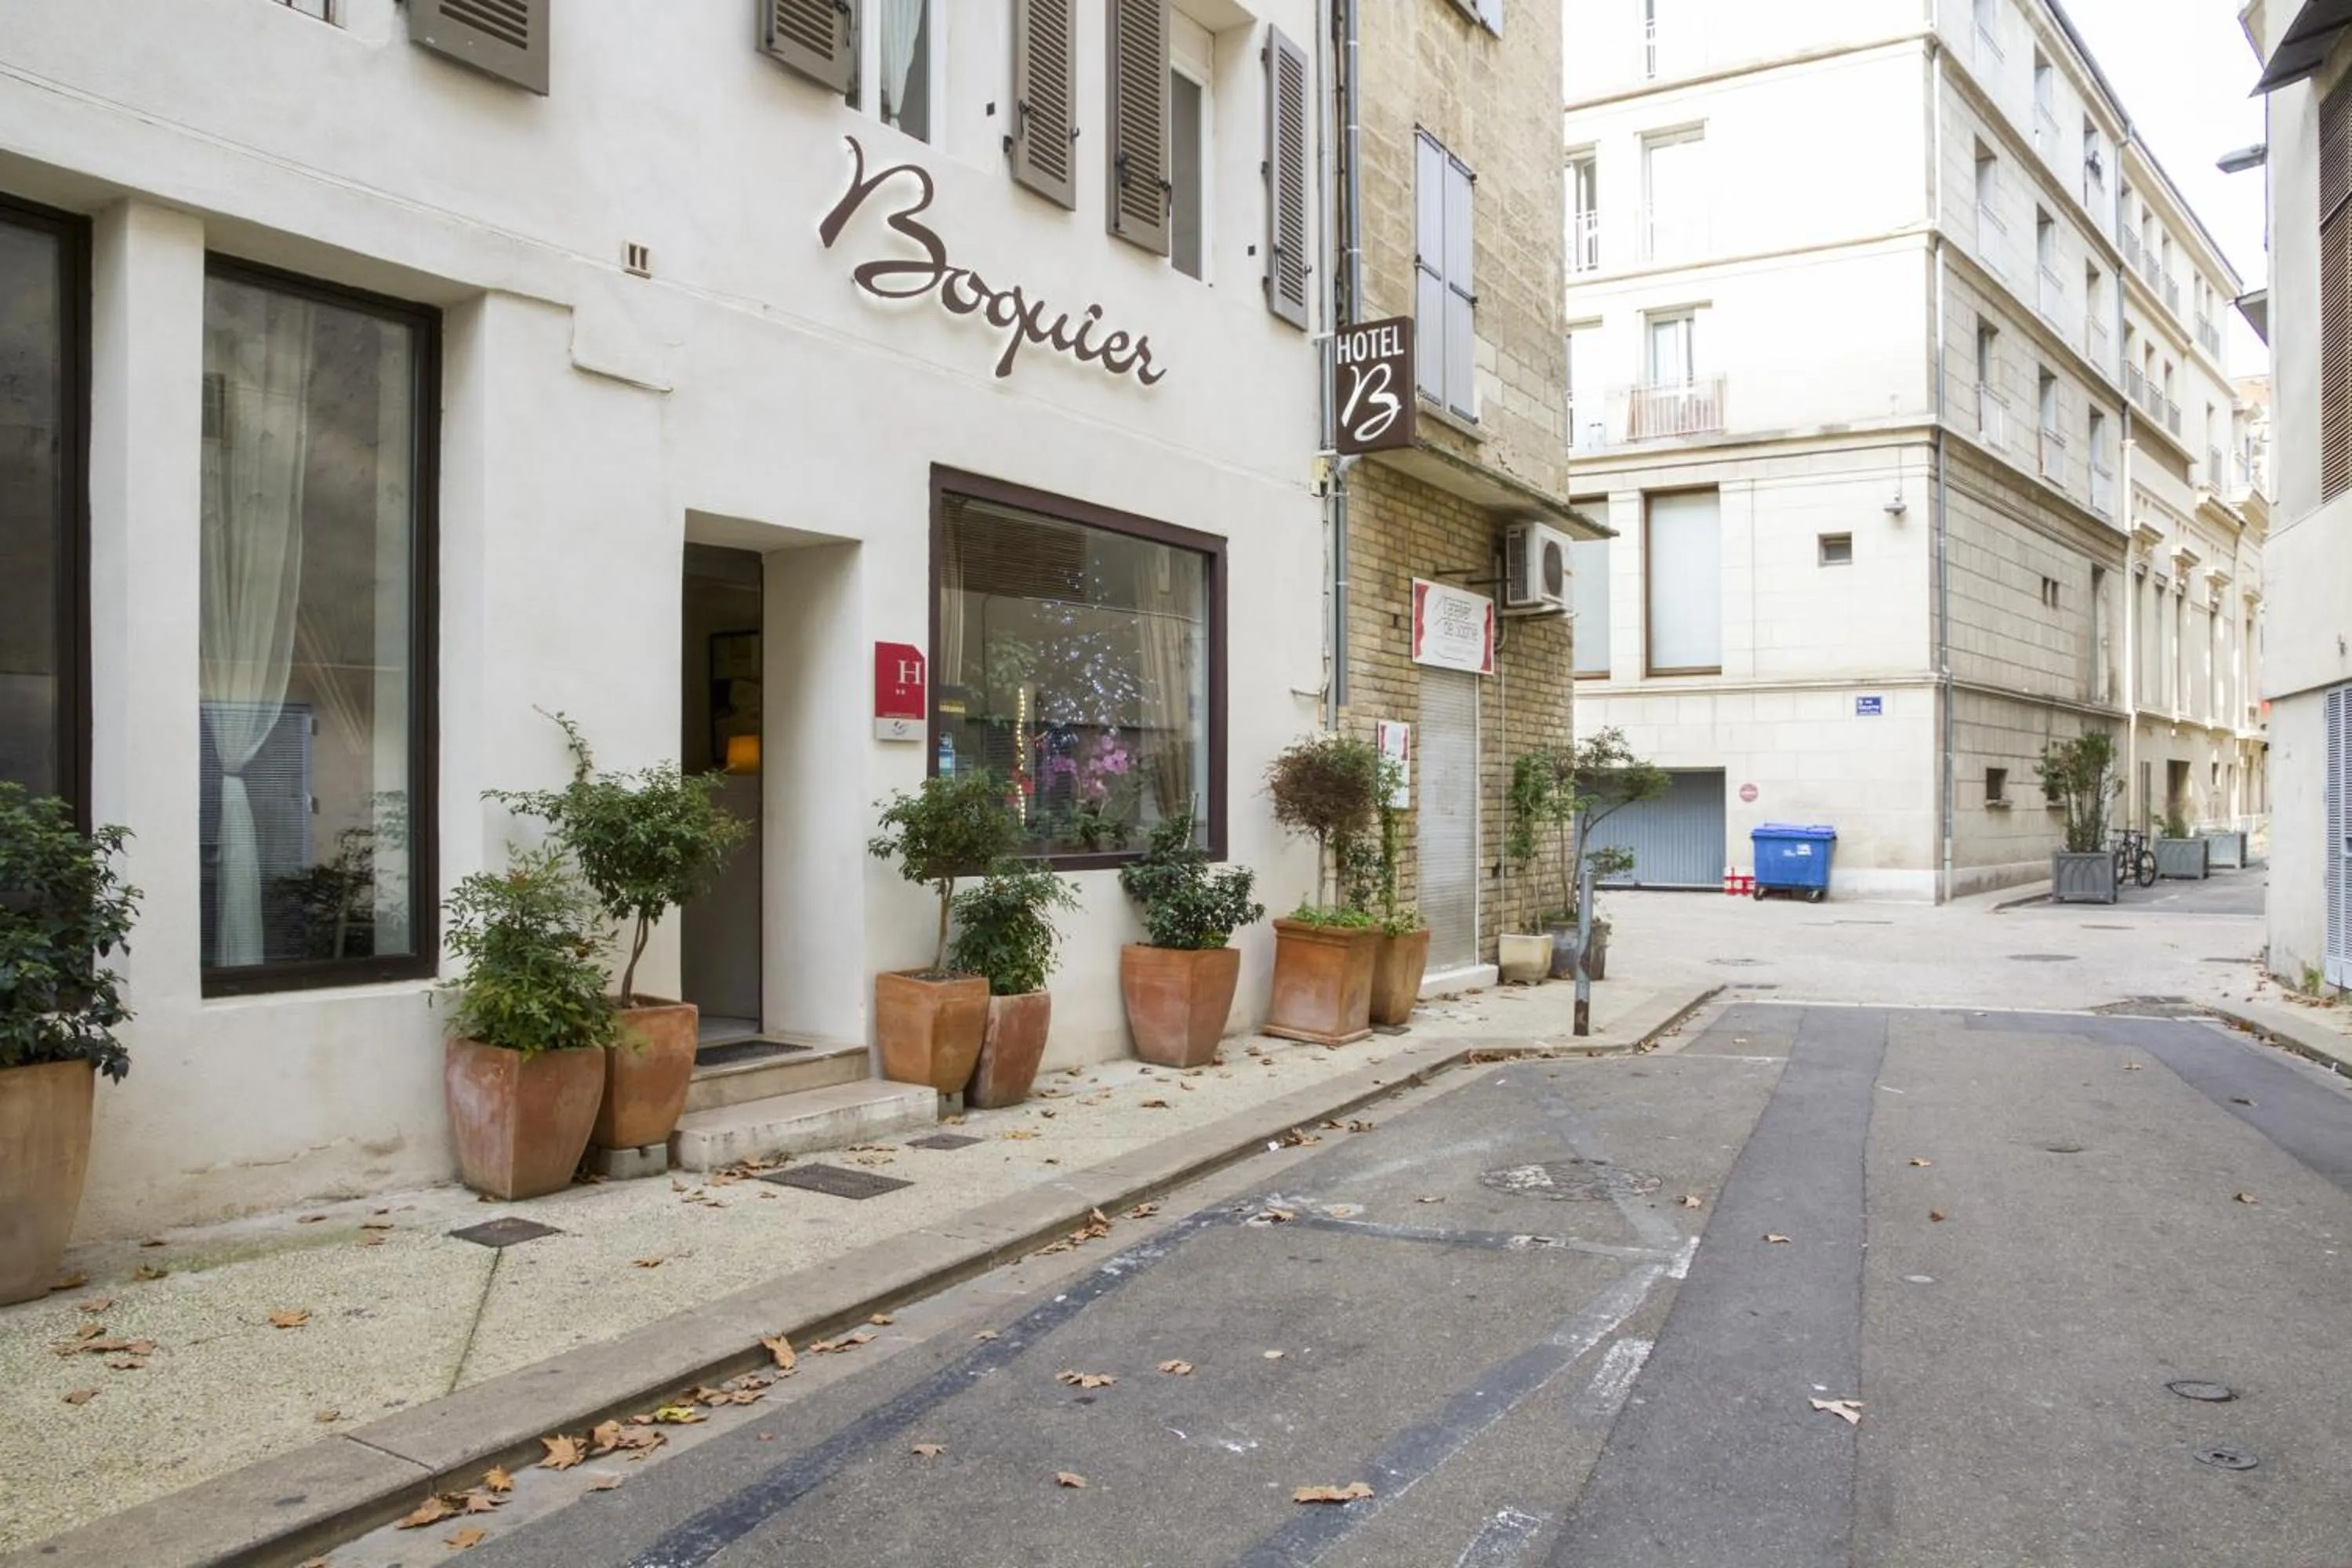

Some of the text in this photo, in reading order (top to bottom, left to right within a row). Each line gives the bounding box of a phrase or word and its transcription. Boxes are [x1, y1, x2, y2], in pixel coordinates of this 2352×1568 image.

[819, 136, 1167, 385] Boquier
[1337, 325, 1404, 364] HOTEL
[1341, 363, 1402, 441] B
[898, 659, 922, 684] H
